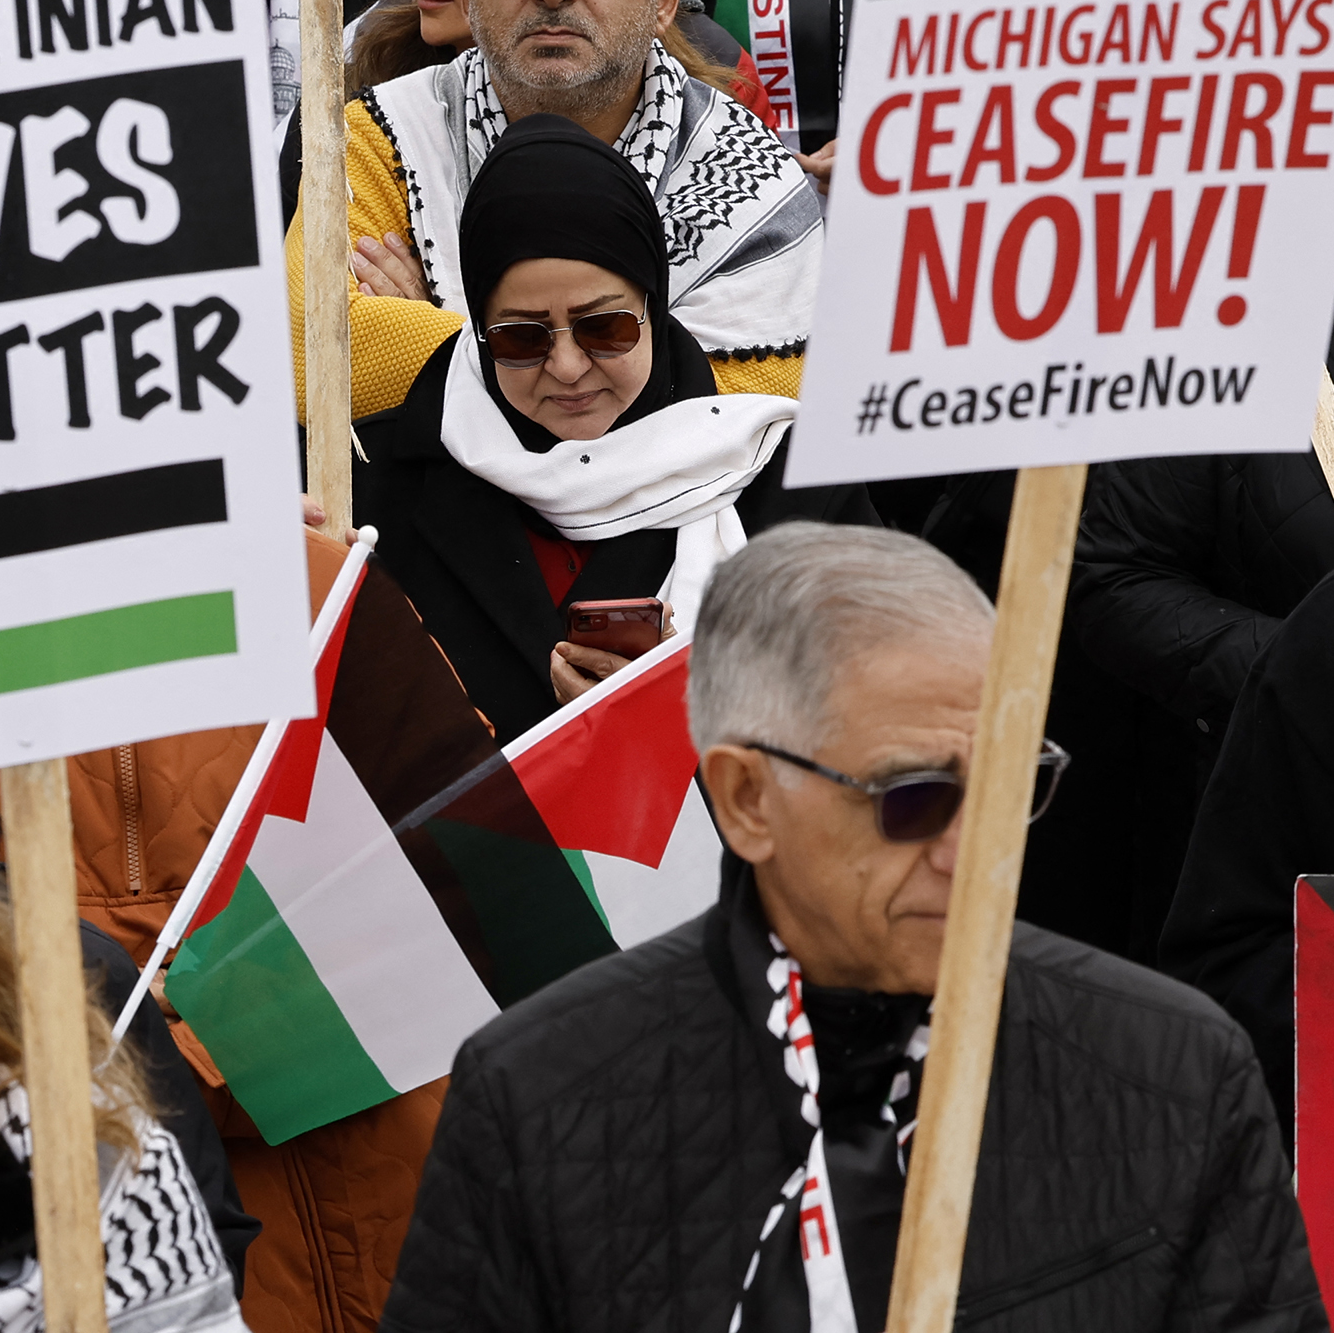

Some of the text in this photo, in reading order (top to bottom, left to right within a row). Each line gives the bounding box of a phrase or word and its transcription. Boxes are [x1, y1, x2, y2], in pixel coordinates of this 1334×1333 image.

[889, 2, 1180, 79] MICHIGAN
[888, 182, 1269, 353] NOW!
[857, 356, 1256, 436] #CeaseFireNow
